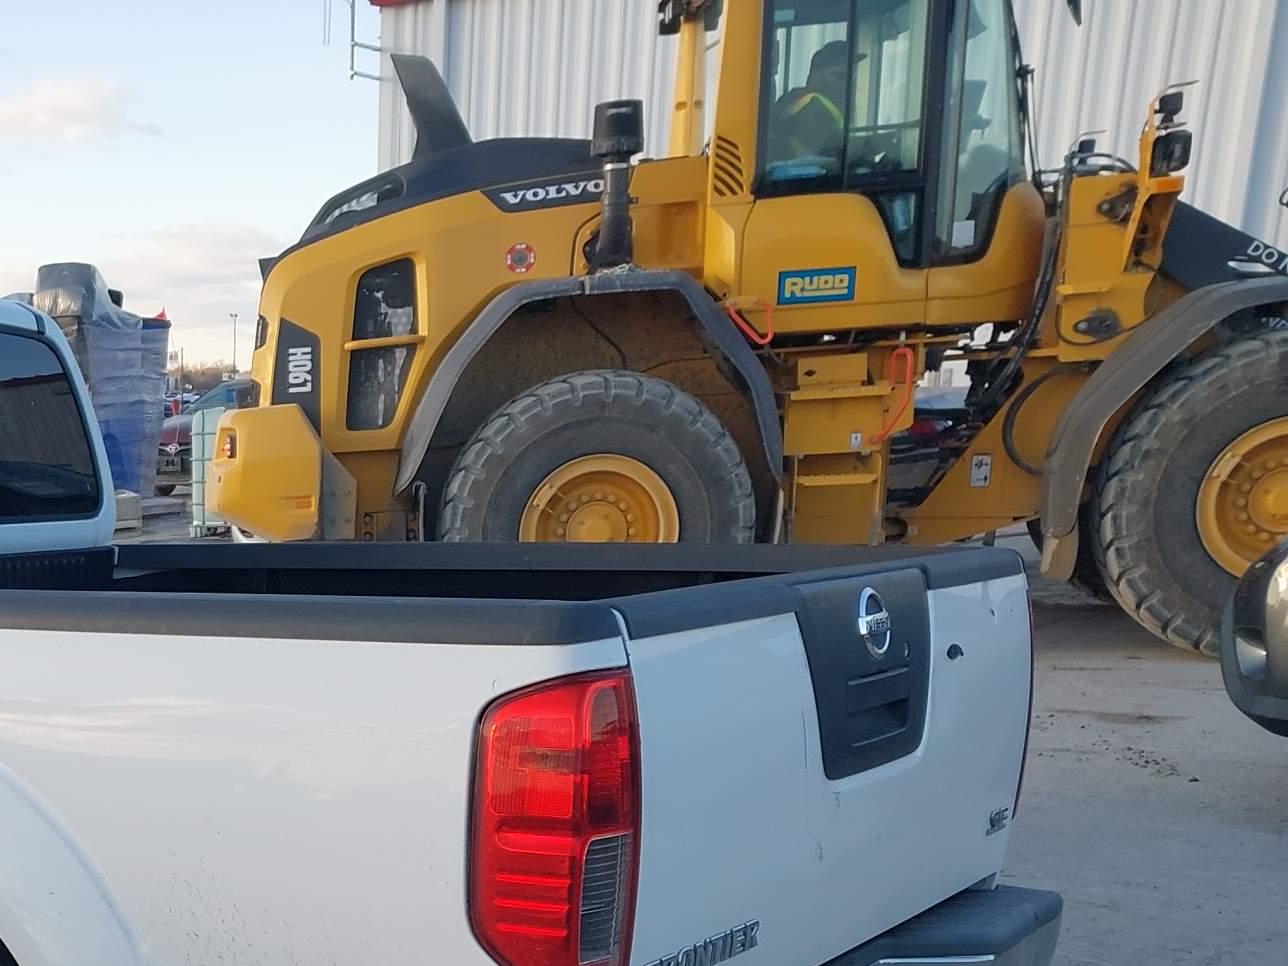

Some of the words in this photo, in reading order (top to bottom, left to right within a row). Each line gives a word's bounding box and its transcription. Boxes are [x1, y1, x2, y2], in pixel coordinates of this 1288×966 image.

[500, 179, 604, 204] VOLVO
[1247, 240, 1278, 263] DO
[784, 274, 849, 298] RUDD
[288, 346, 312, 393] L90H
